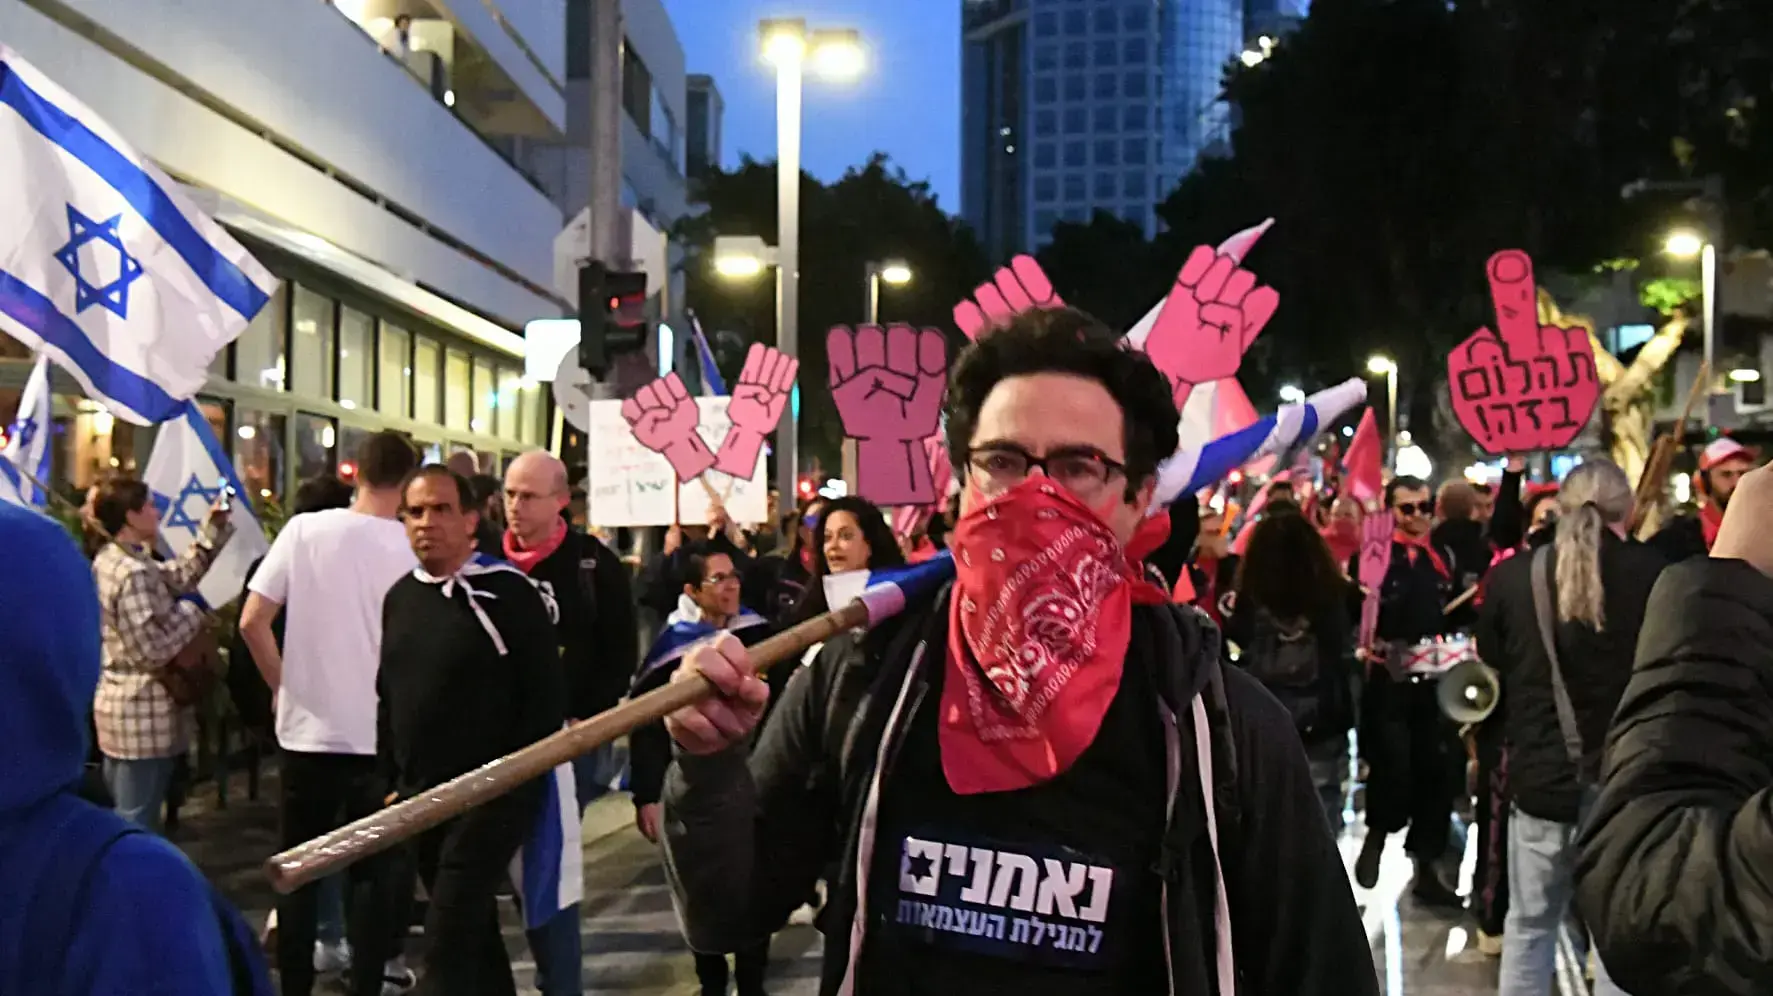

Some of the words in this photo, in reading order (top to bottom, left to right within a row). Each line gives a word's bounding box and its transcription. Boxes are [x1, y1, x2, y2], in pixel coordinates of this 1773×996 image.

[1458, 349, 1593, 401] תהלום
[1476, 397, 1578, 441] בזה!
[899, 837, 1113, 923] נאמנים
[896, 899, 1005, 940] העצמאות
[1009, 917, 1104, 954] למגילת
